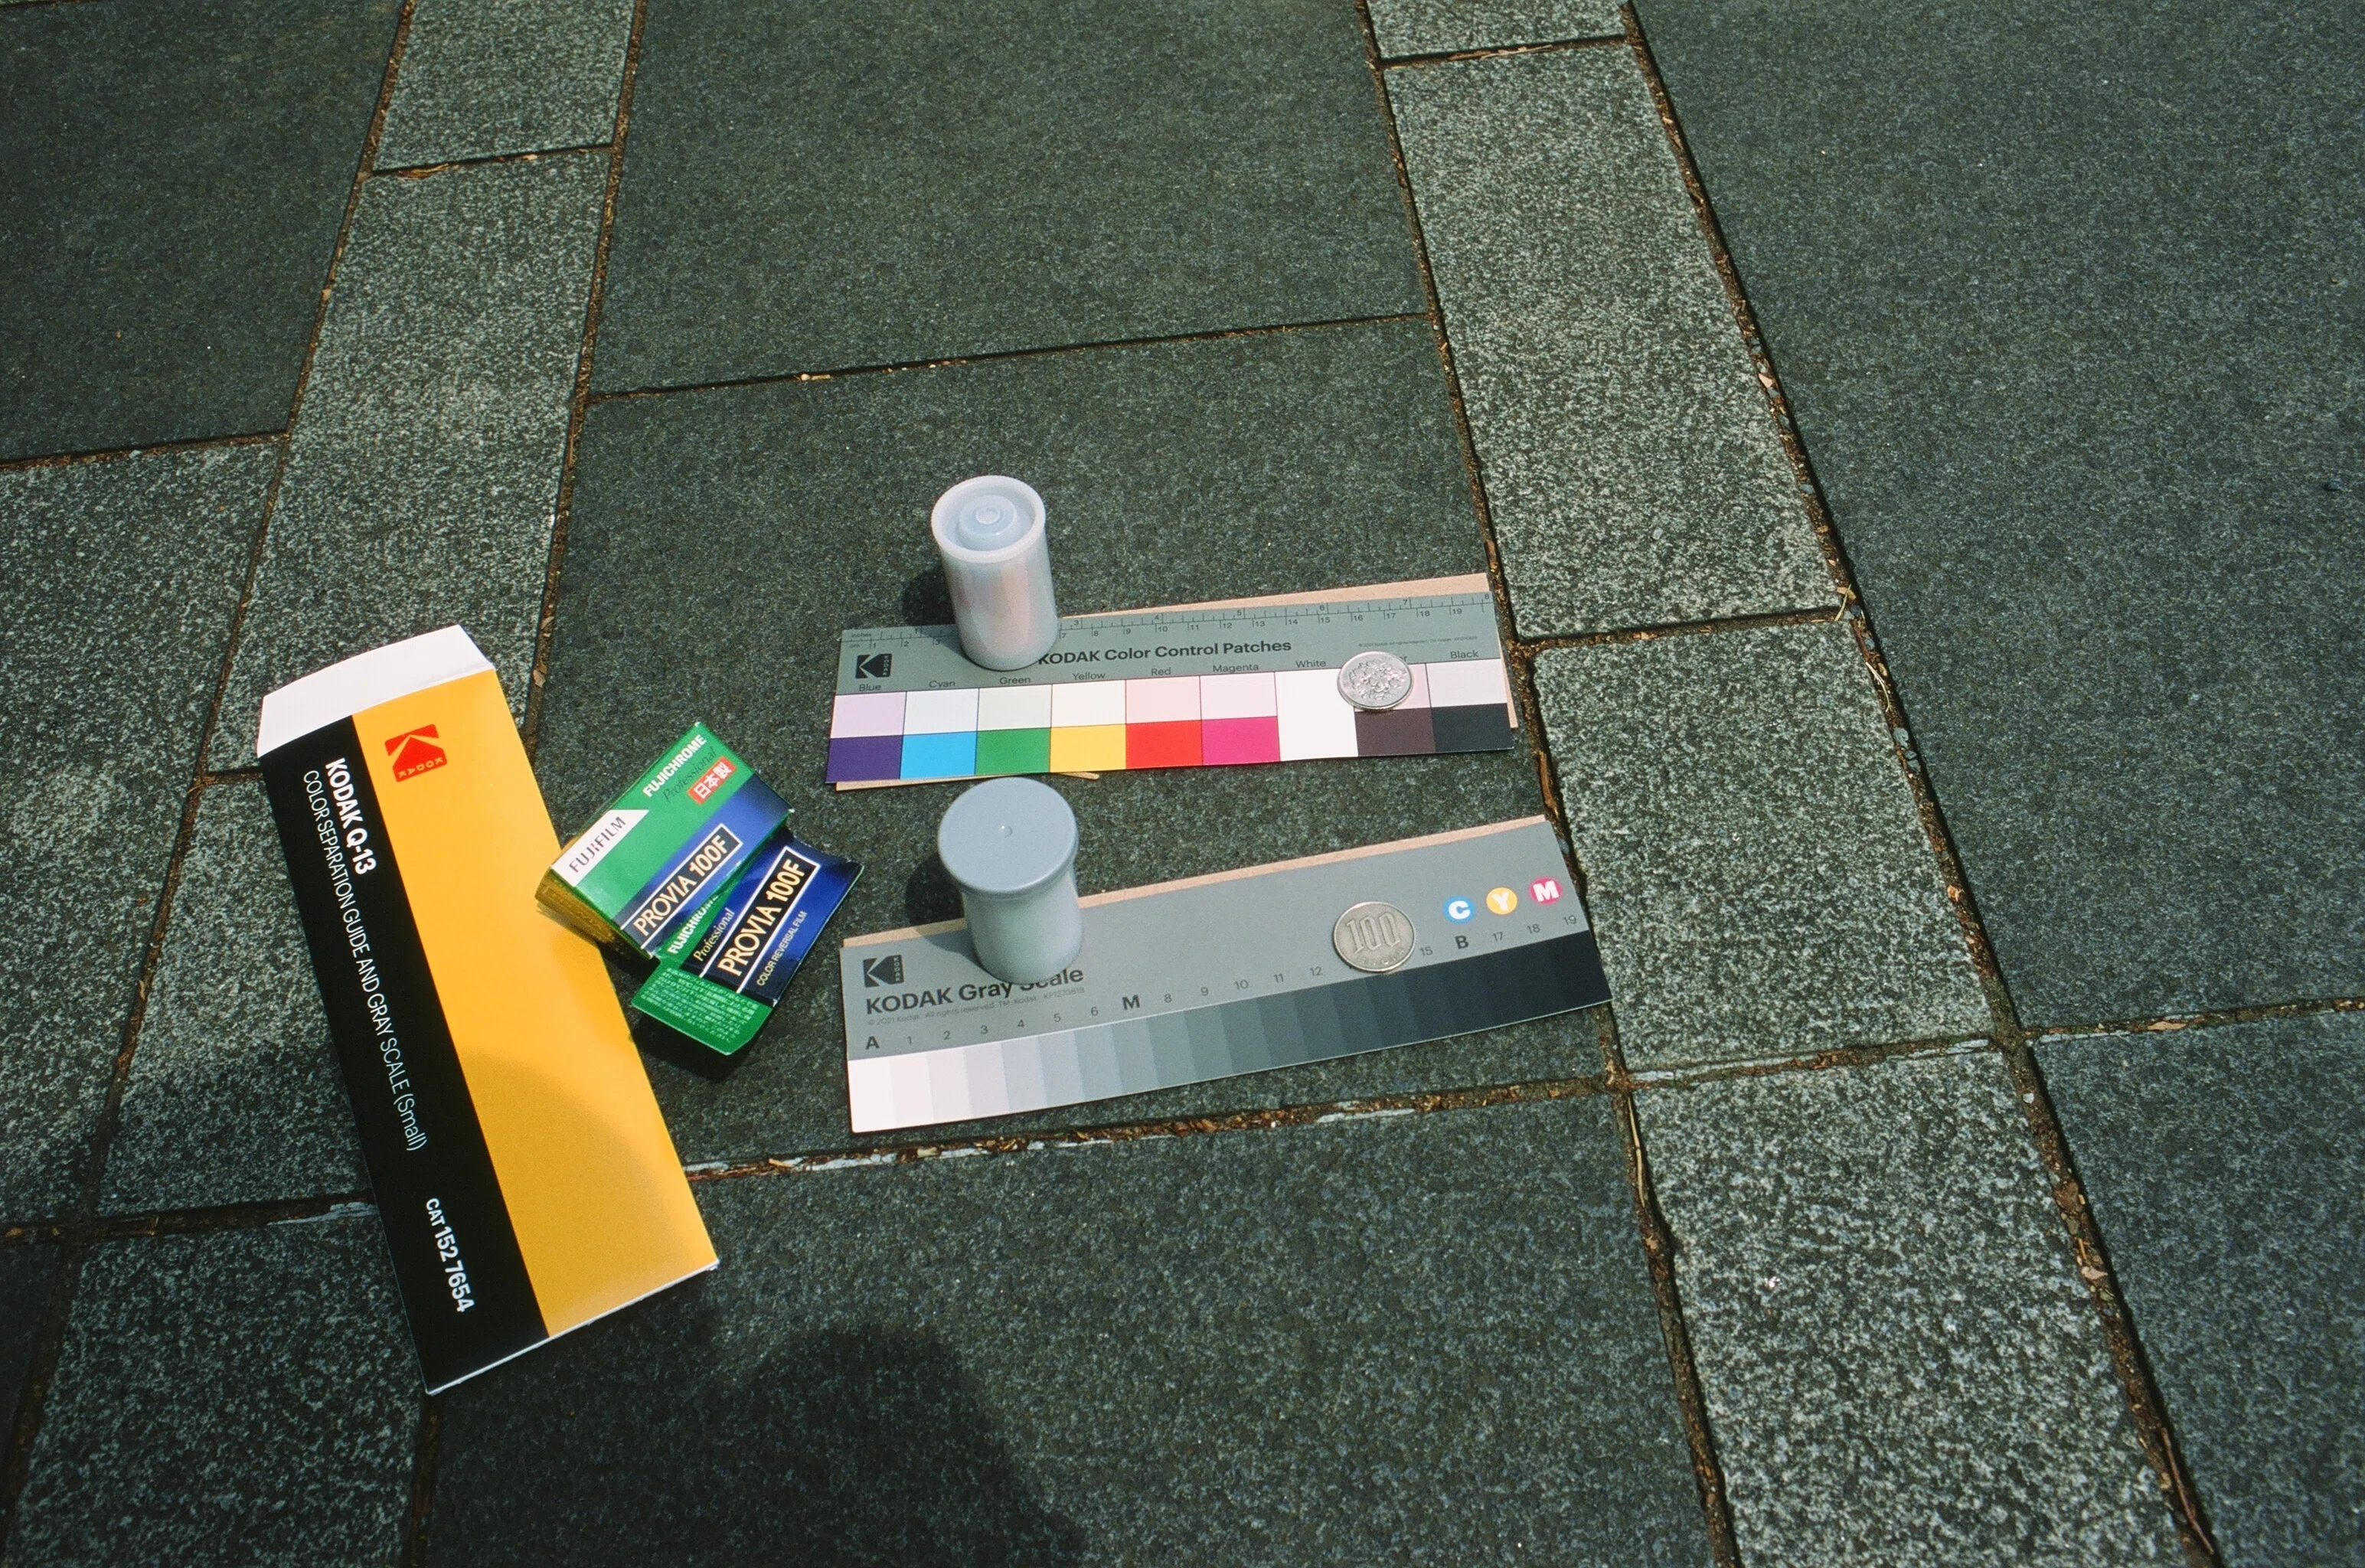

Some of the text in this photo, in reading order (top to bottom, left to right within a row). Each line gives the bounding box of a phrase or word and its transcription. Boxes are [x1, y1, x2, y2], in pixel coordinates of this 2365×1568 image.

[1104, 647, 1151, 661] Color
[1155, 642, 1219, 658] Control
[1223, 640, 1292, 654] Patches
[1151, 667, 1171, 676] Red
[1213, 663, 1259, 674] Magenta
[1295, 659, 1327, 668] White
[1450, 649, 1479, 659] Black
[929, 680, 956, 689] Cyan
[999, 675, 1031, 685] Green
[1072, 672, 1106, 681] Yellow
[397, 756, 444, 779] KODAK
[642, 734, 707, 798] FUJICHROME
[661, 745, 717, 804] Professional
[693, 761, 732, 799] 日本製
[325, 757, 377, 875] KODAK Q-13
[568, 815, 627, 874] FUJIFILM
[632, 833, 730, 937] PROVIA 100F
[1448, 880, 1560, 920] C Y M
[667, 894, 719, 955] FUJICHRO
[693, 906, 736, 962] Professional
[717, 858, 808, 976] PROVIA 100F
[1346, 912, 1402, 955] 100
[303, 769, 428, 1152] COLOR SEPARATION GUIDE AND GRAY SCALE (Small)
[756, 910, 808, 987] COLOR REVERSAL FILM
[893, 957, 901, 982] KODAK
[865, 914, 1577, 1050] A 1 2 3 4 5 6 M 8 9 10 11 12 15 B 17 18 19
[866, 968, 1084, 1015] KODAK Gray ale
[426, 1197, 475, 1313] CAT 152 7654
